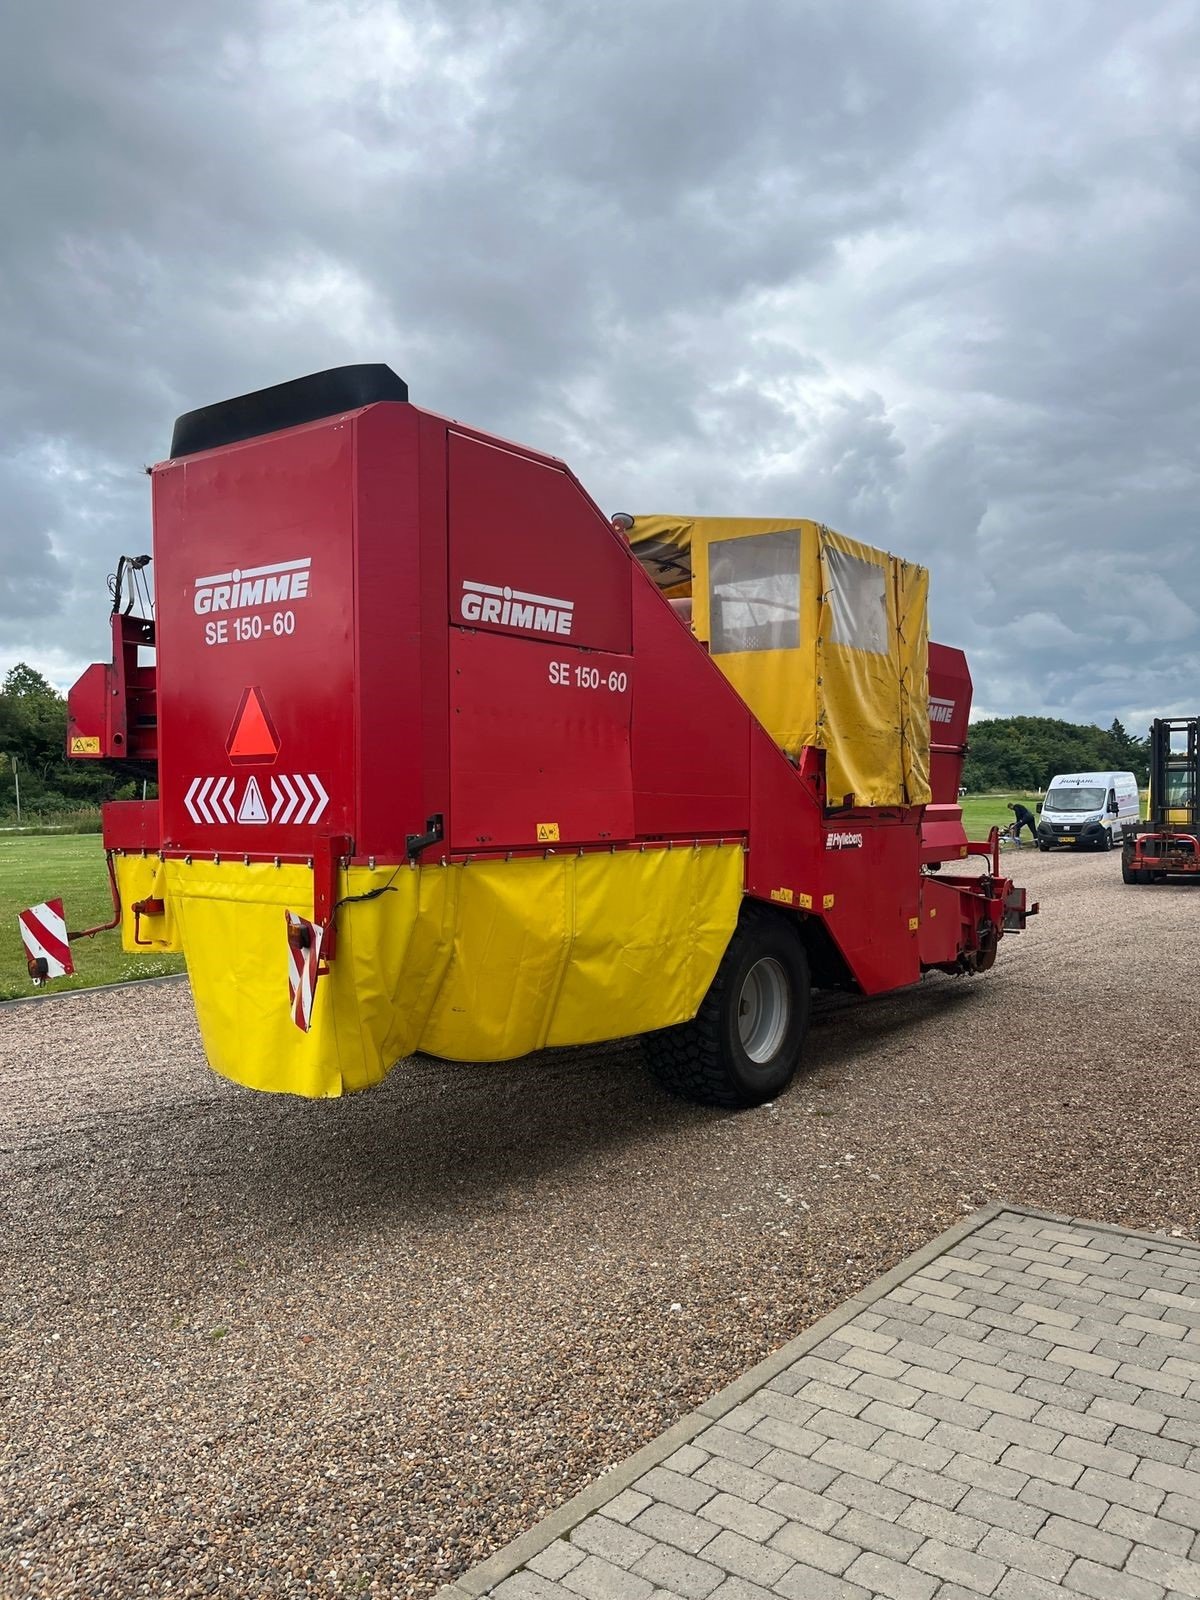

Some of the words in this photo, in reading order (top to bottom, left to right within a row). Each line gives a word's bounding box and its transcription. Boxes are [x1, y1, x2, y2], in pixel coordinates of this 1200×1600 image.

[194, 566, 310, 615] GRIMME
[461, 585, 573, 636] GRIMME
[205, 621, 229, 645] SE
[233, 610, 295, 641] 150-60
[548, 661, 570, 686] SE
[575, 666, 627, 693] 150-60
